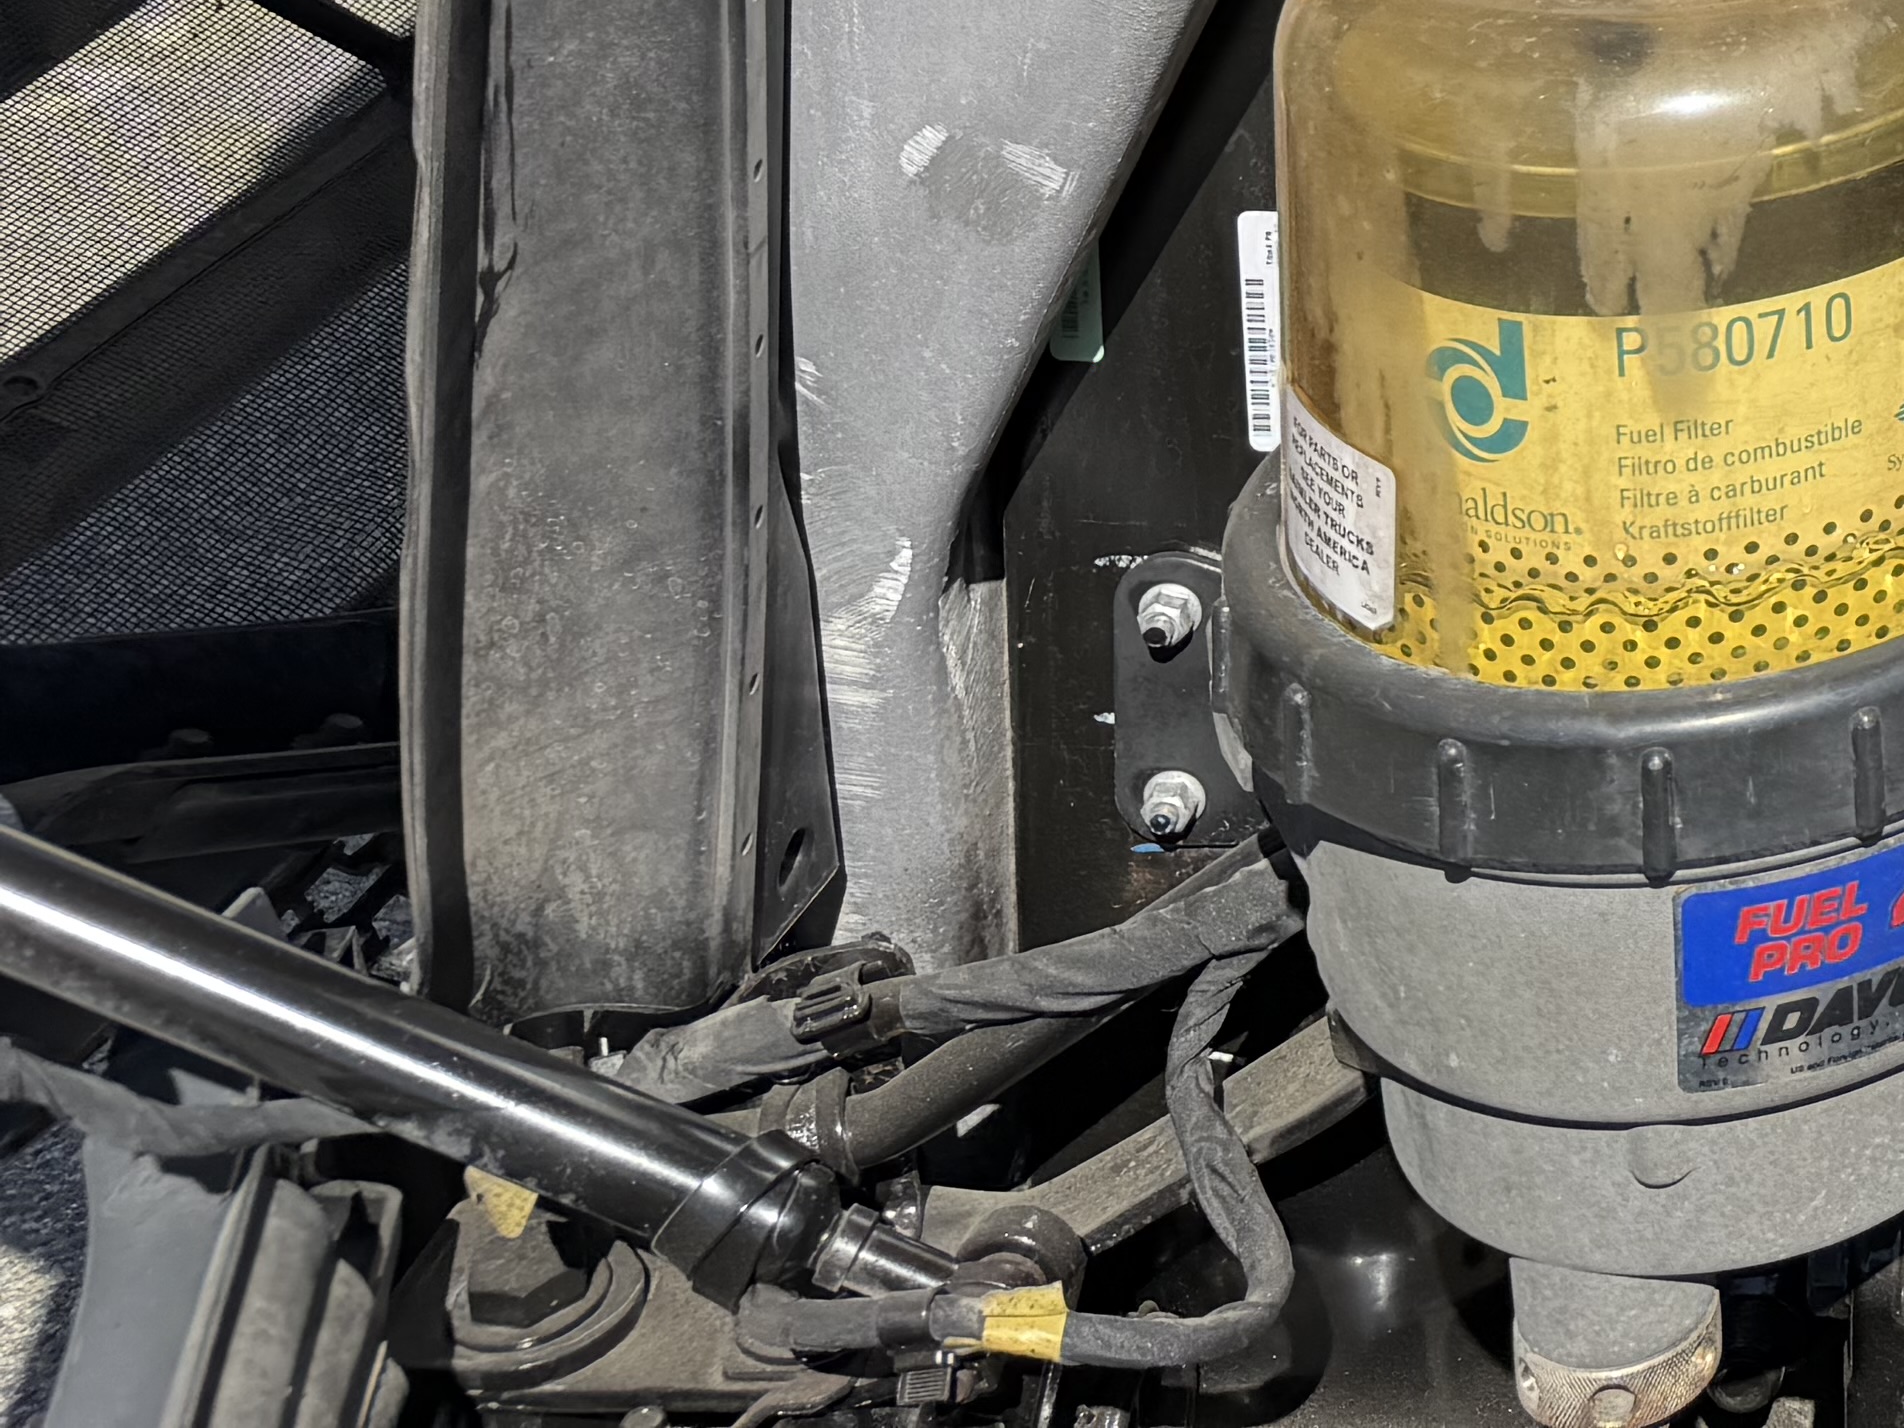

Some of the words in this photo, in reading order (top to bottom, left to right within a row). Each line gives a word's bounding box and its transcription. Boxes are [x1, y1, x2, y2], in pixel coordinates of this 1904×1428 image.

[1293, 416, 1308, 445] FOR
[1309, 435, 1339, 471] PARTS
[1342, 464, 1359, 486] OR
[1616, 425, 1665, 445] Fuel
[1673, 418, 1734, 442] Filter
[1618, 456, 1676, 477] Filtro
[1686, 451, 1714, 473] de
[1723, 417, 1863, 469] combustible
[1301, 466, 1316, 494] SEE
[1317, 484, 1346, 519] YOUR
[1619, 488, 1678, 510] Filtre
[1688, 484, 1701, 505] à
[1710, 459, 1827, 502] carburant
[1324, 510, 1374, 556] TRUCKS
[1458, 488, 1583, 535] aldson
[1622, 505, 1788, 541] Kraftstofffilter
[1304, 531, 1340, 576] DEALER
[1317, 528, 1370, 575] AMERICA
[1485, 529, 1572, 551] SOLUTIONS
[1735, 879, 1868, 945] FUEL
[1749, 920, 1864, 983] PRO
